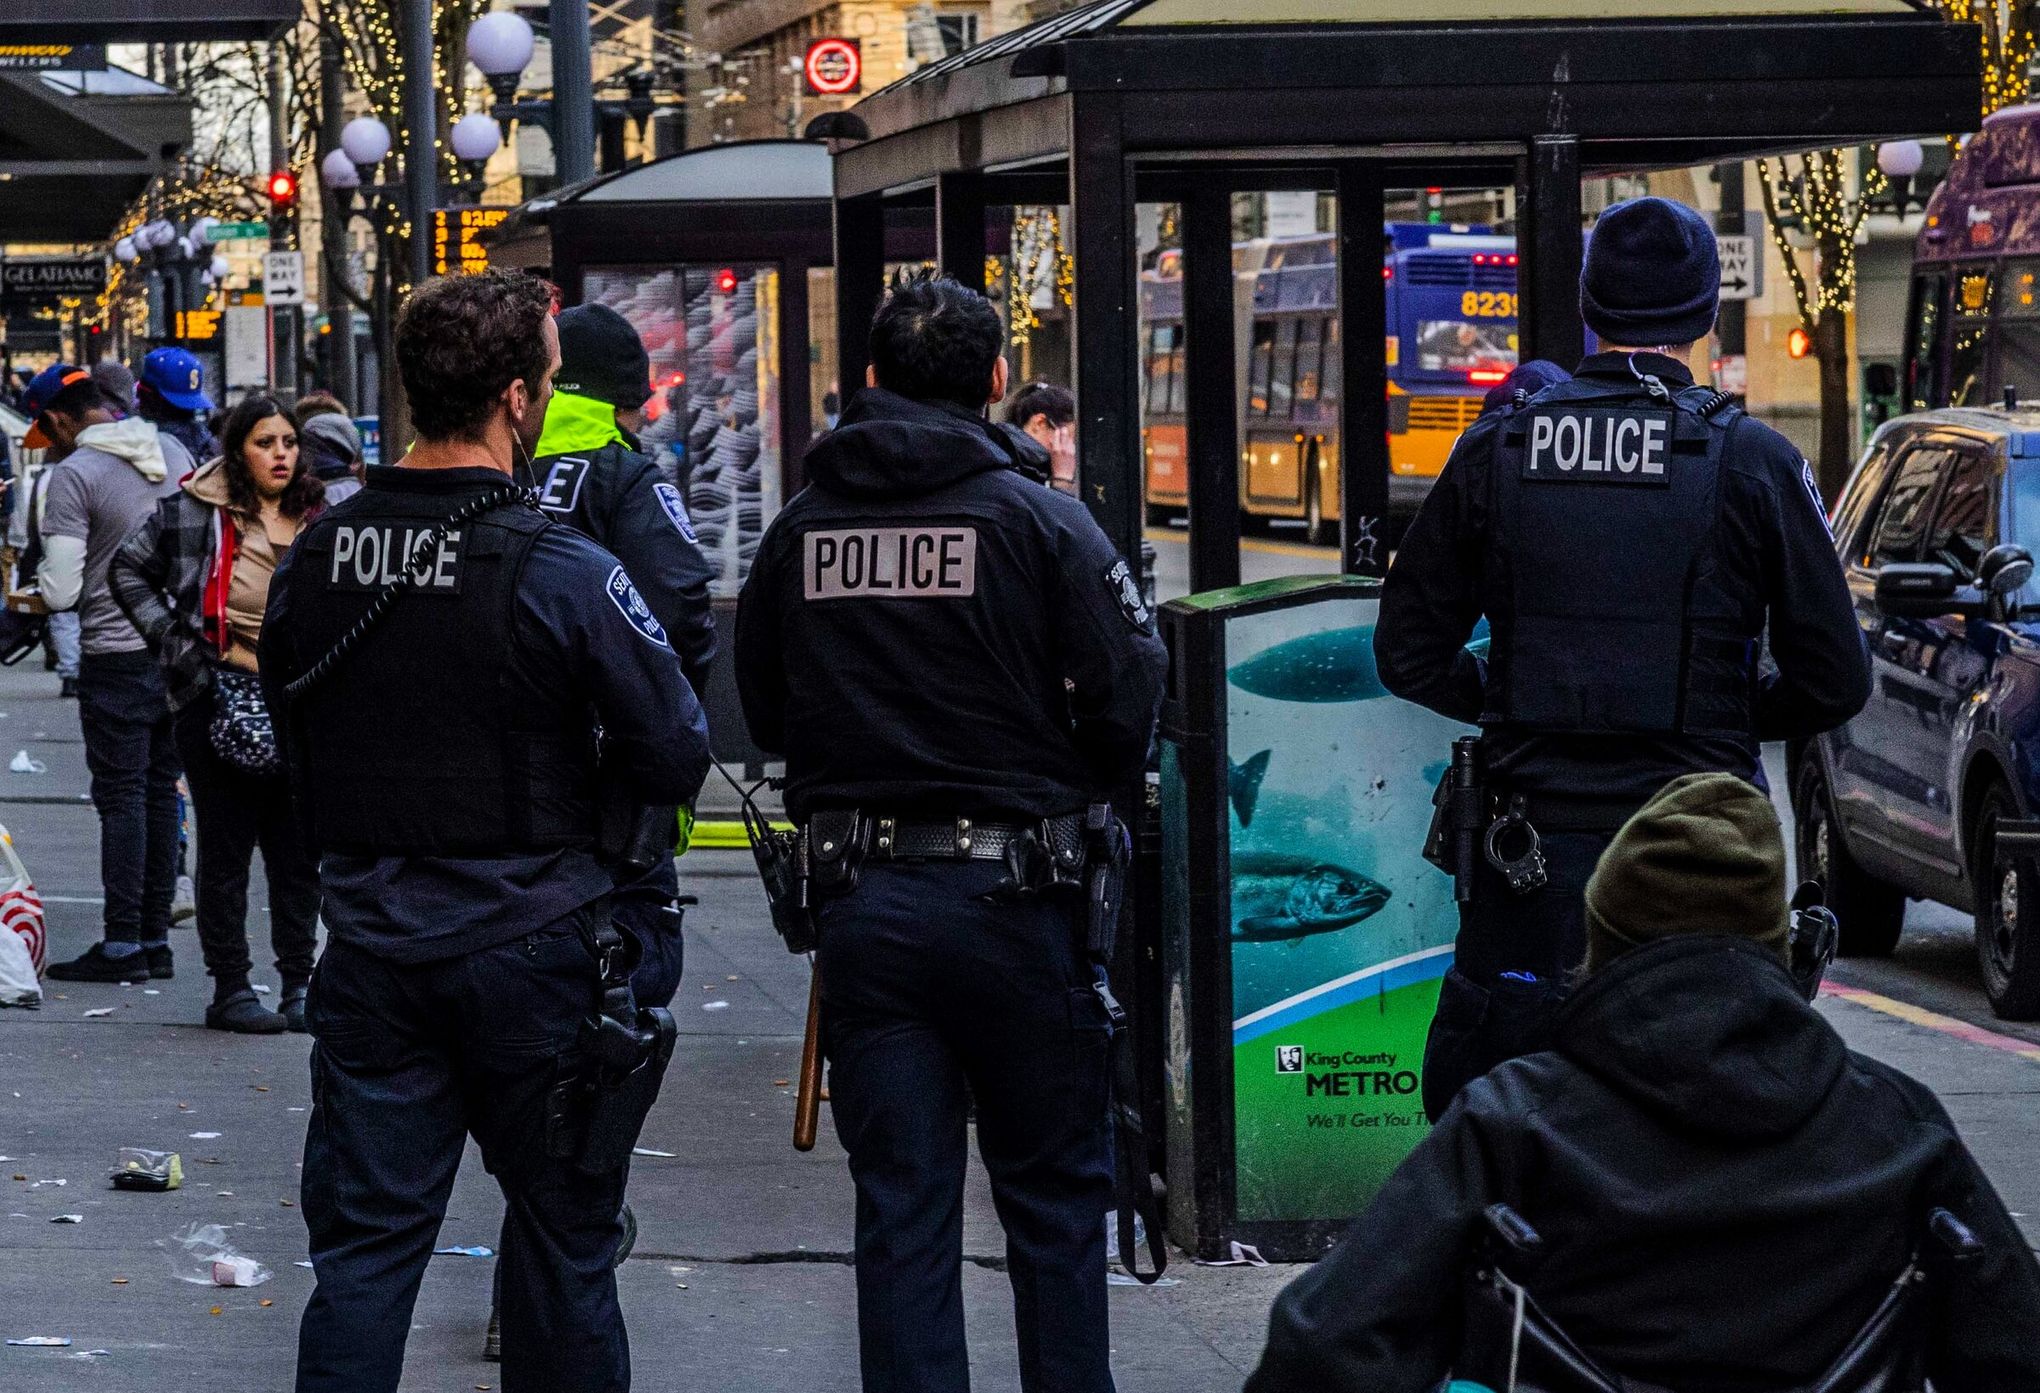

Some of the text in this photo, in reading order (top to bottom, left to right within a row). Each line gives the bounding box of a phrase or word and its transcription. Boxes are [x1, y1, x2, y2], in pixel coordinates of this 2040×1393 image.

[270, 256, 294, 267] ONE
[271, 271, 296, 280] WAY
[1530, 415, 1666, 474] POLICE
[331, 526, 461, 587] POLICE
[815, 533, 964, 592] POLICE
[1306, 1051, 1397, 1068] King County
[1306, 1070, 1418, 1097] METRO
[1351, 1112, 1380, 1128] Get
[1383, 1112, 1411, 1127] You
